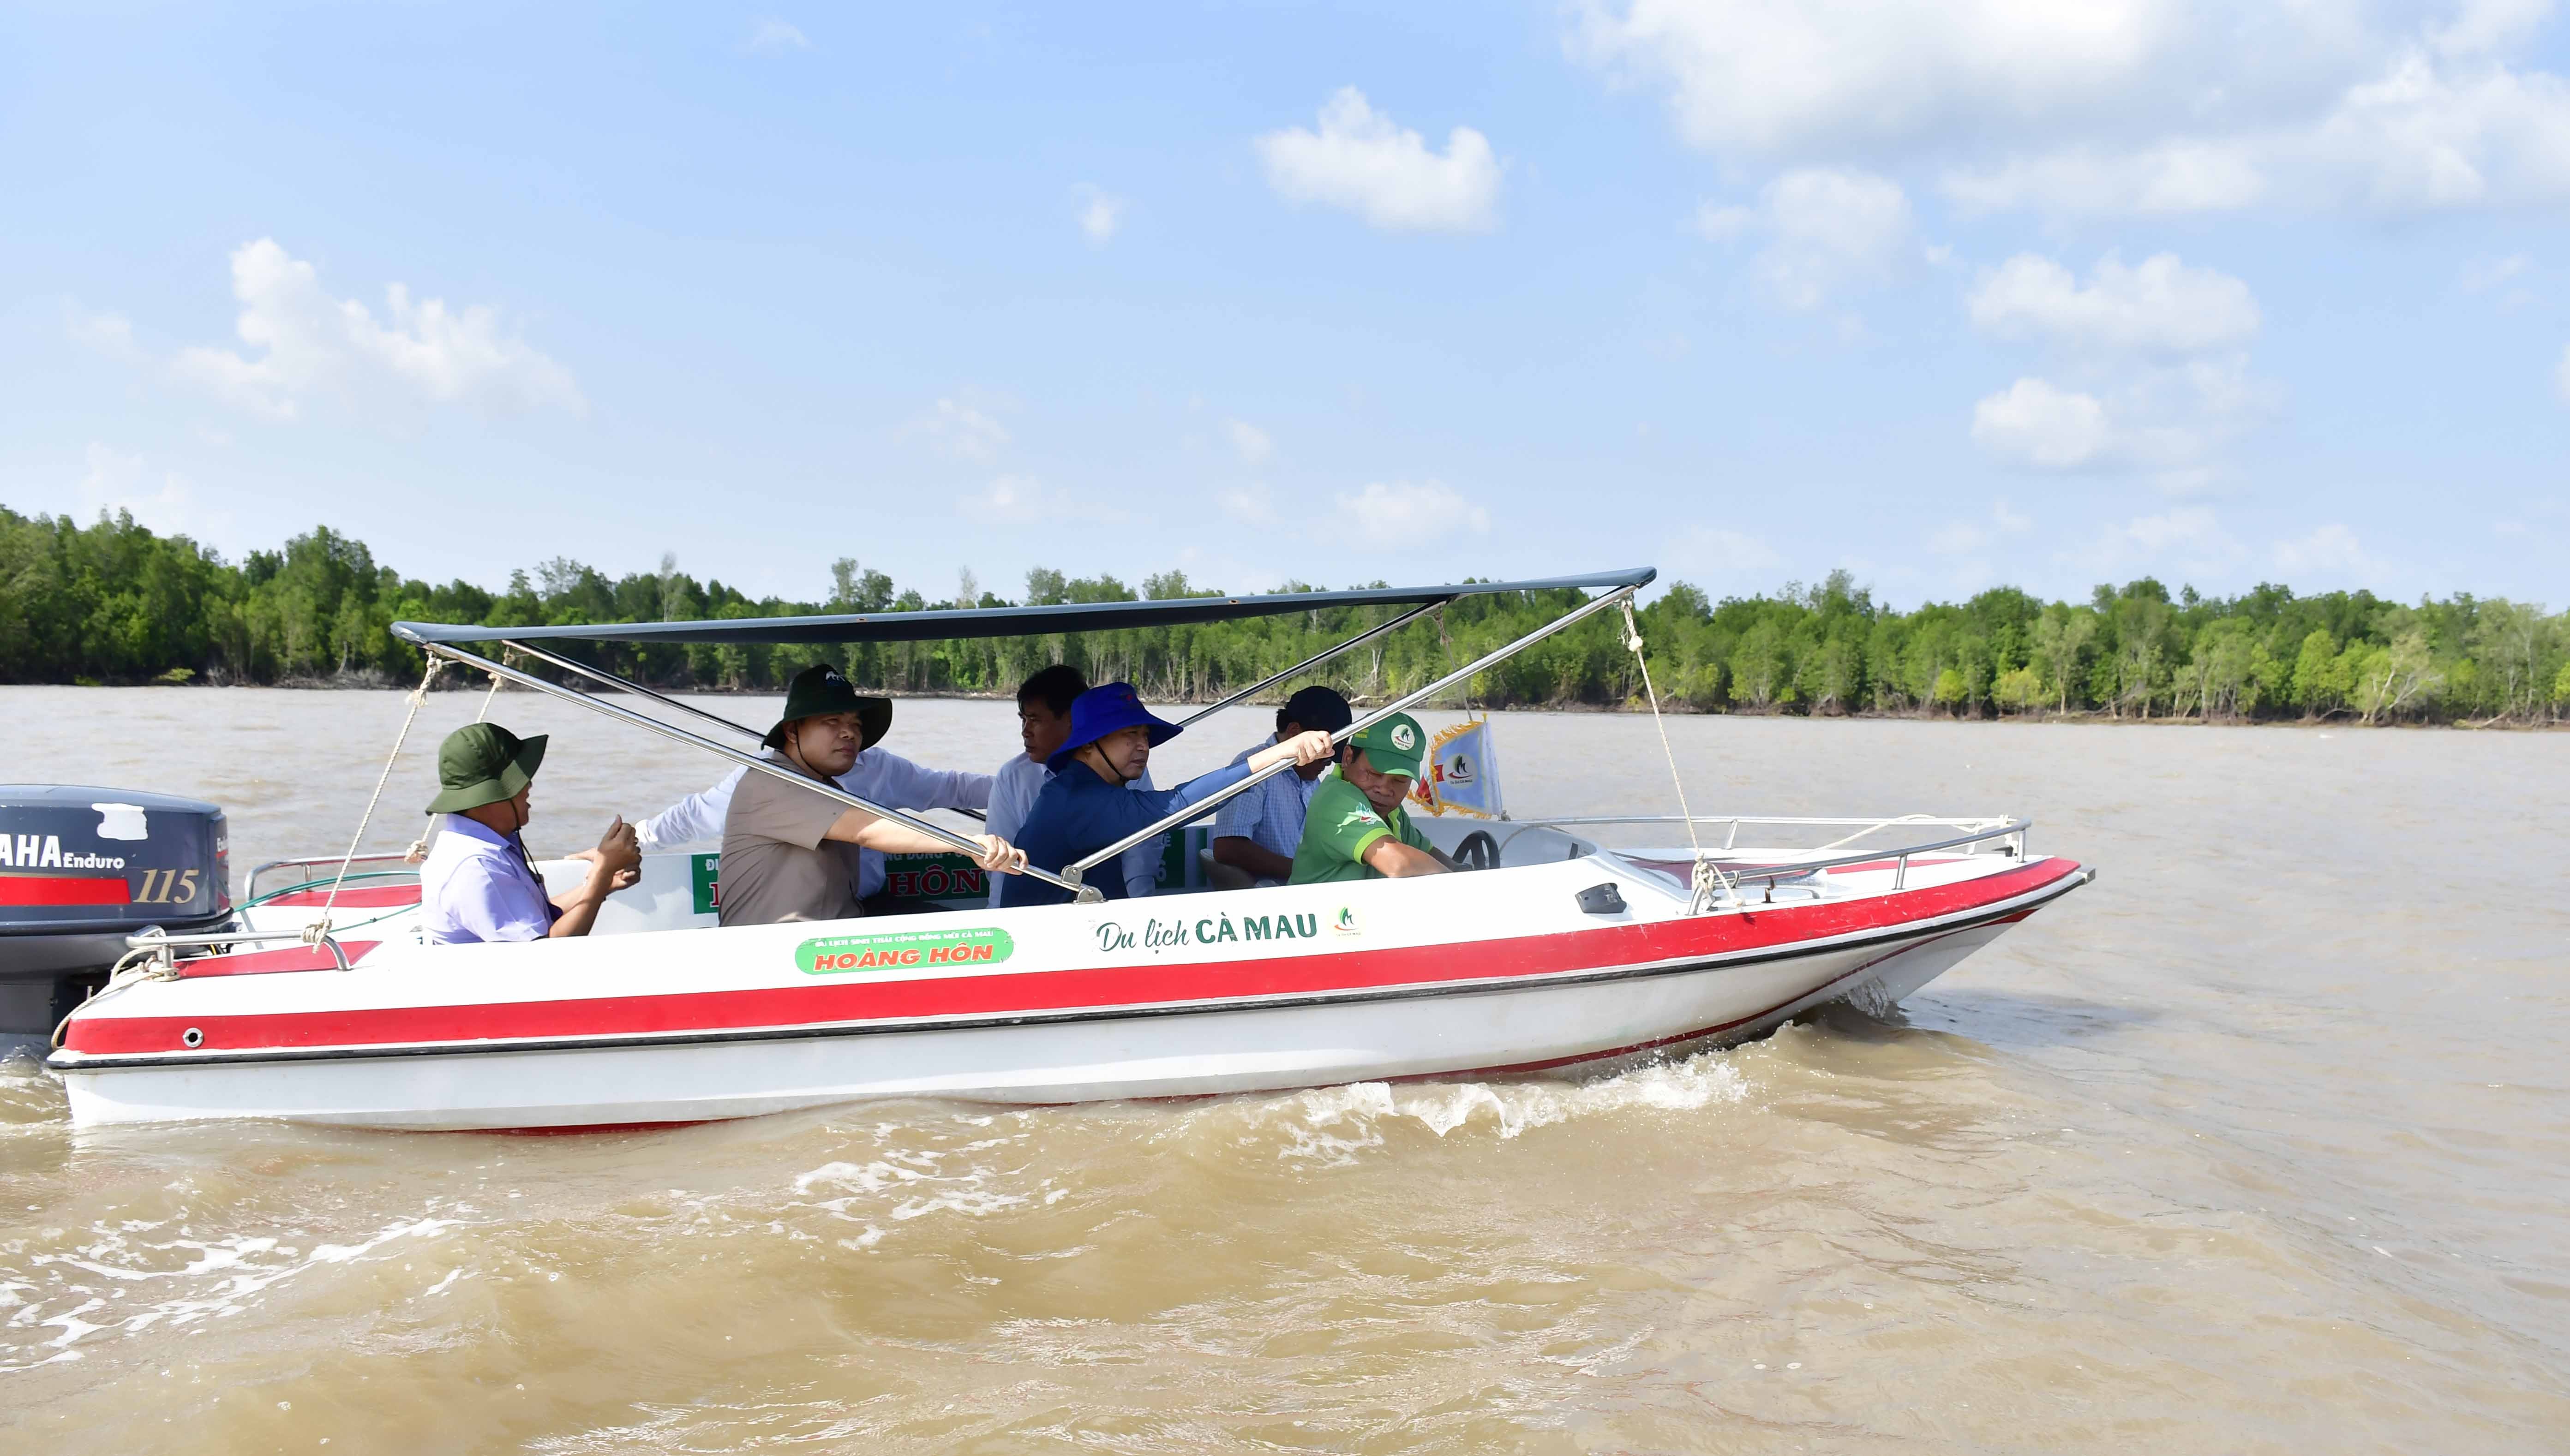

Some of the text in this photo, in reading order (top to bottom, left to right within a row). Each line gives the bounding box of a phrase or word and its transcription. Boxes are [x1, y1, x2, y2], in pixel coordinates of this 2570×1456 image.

[63, 852, 125, 869] Enduro
[133, 869, 199, 904] 115
[1096, 912, 1317, 954] Du lịch CÀ MAU
[814, 942, 993, 971] HOÀNG HÔN
